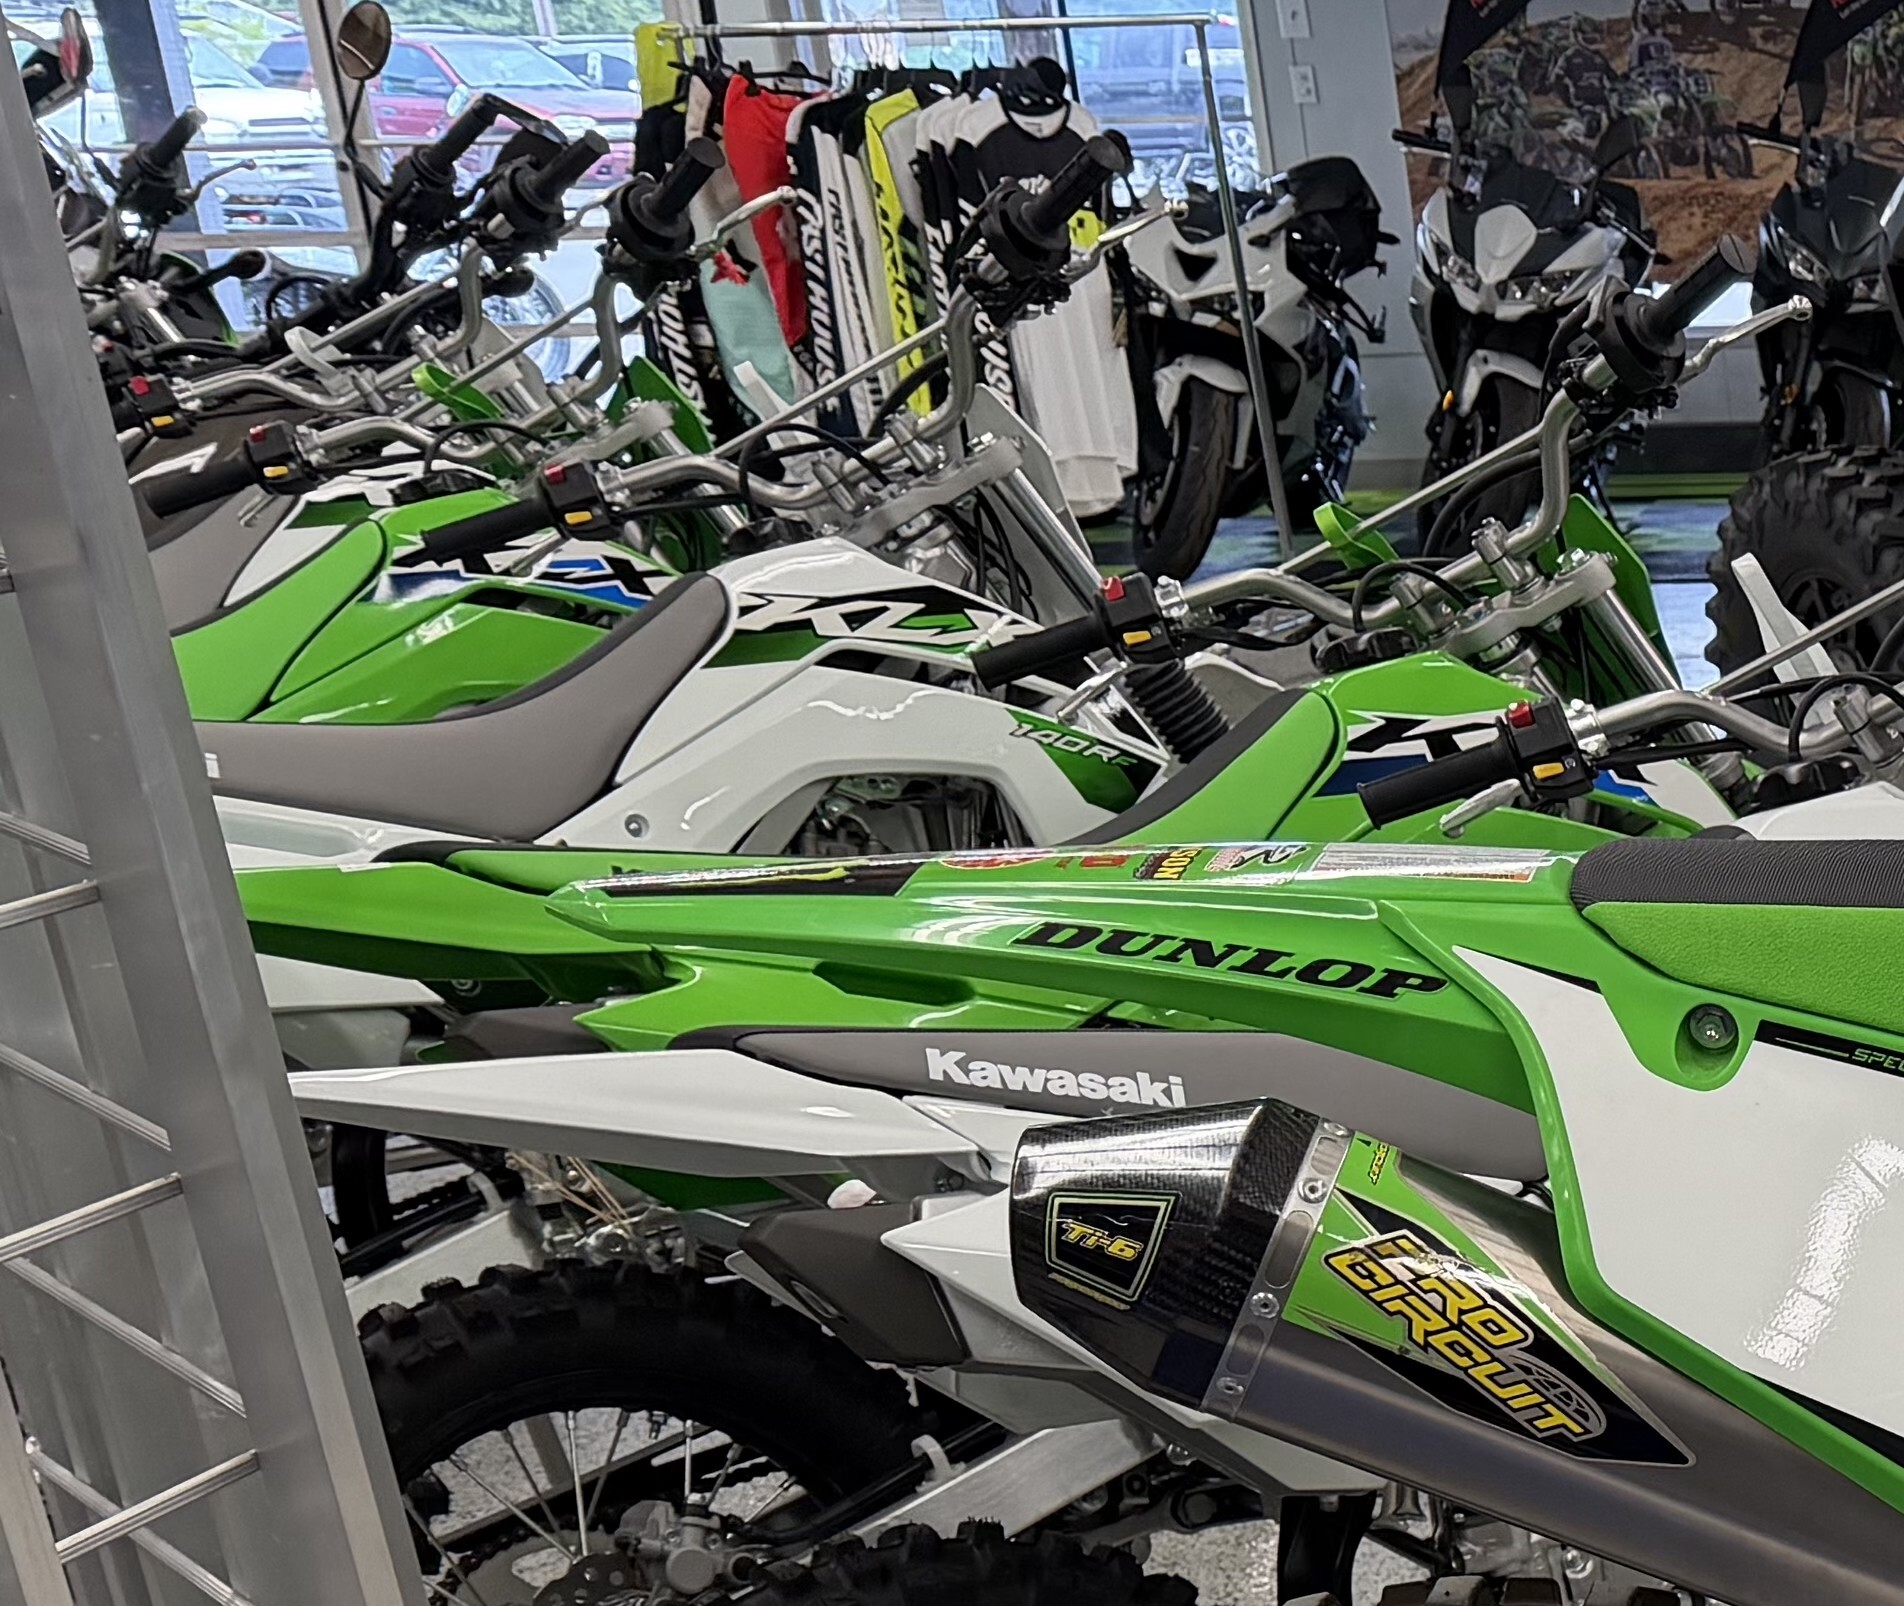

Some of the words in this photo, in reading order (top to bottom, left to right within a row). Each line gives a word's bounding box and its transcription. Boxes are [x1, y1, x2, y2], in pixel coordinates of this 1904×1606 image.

[1011, 921, 1450, 1000] DUNLOP
[925, 1047, 1186, 1108] Kawasaki
[1061, 1219, 1144, 1262] Ti-6
[1324, 1246, 1590, 1441] CIRCUIT
